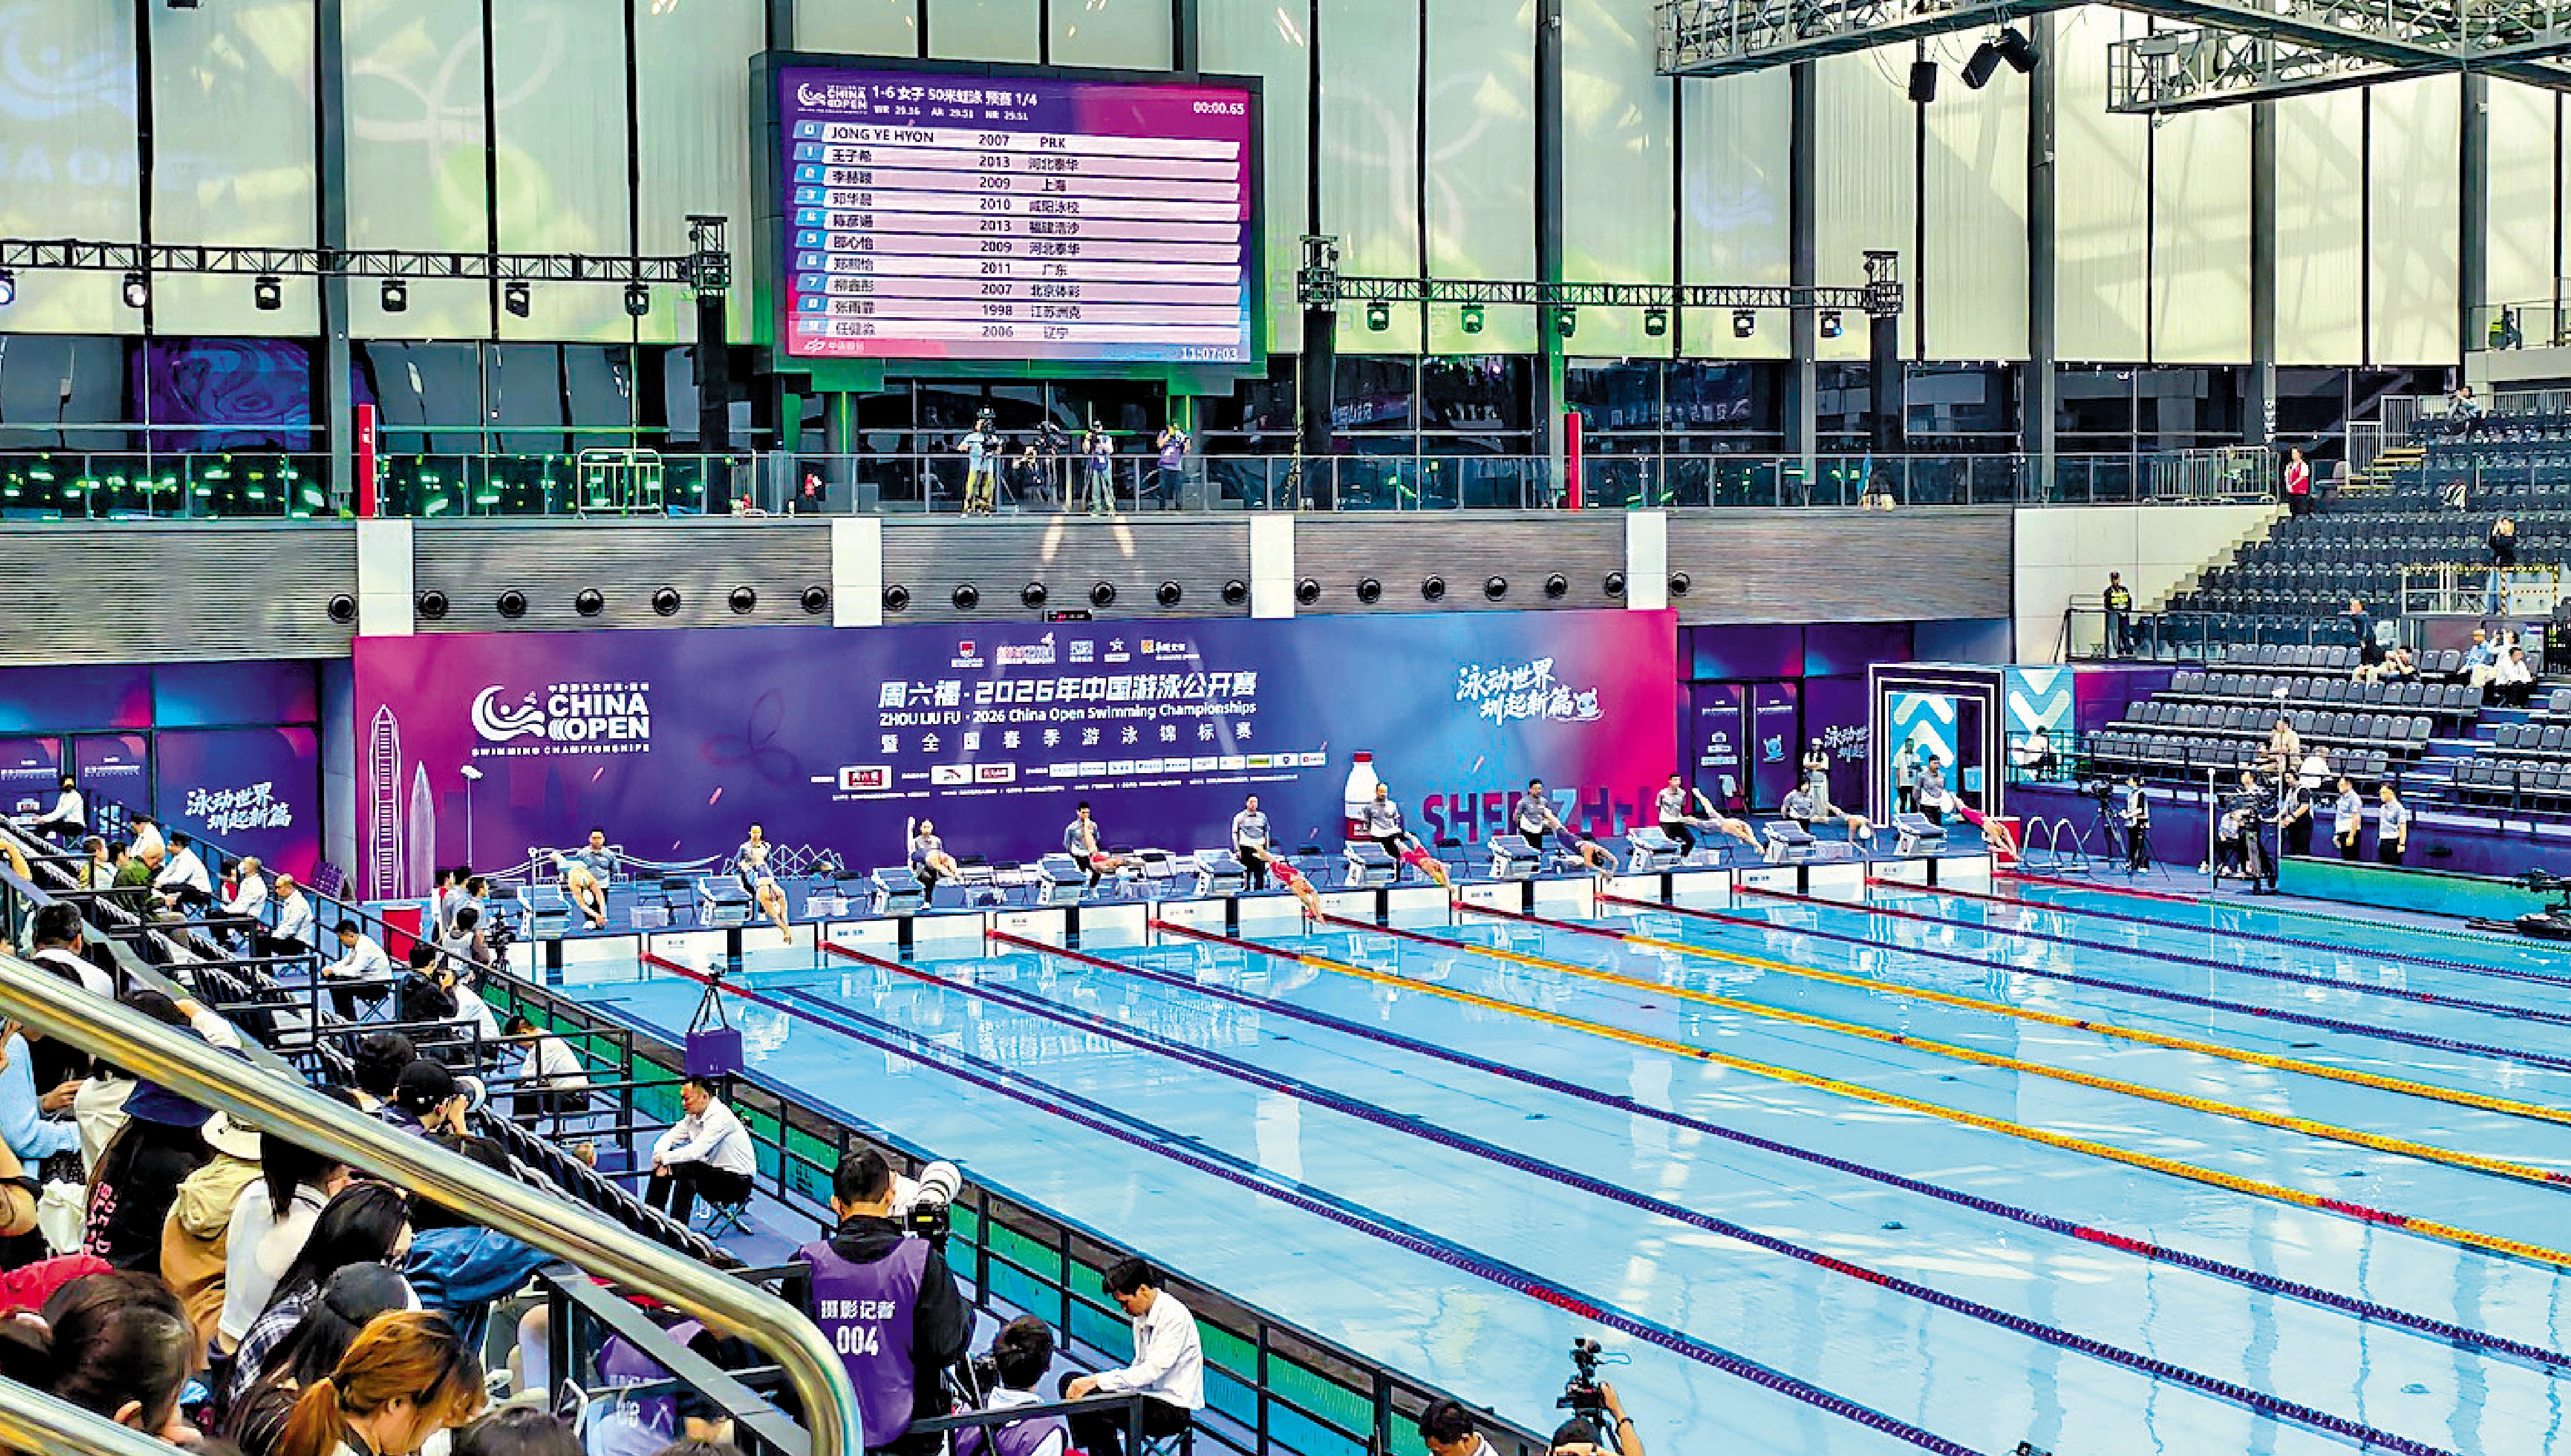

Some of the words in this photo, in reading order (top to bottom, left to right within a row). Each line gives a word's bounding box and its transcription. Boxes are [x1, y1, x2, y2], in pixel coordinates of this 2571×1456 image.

[873, 85, 894, 99] 1-6
[898, 87, 925, 101] 女子
[1015, 93, 1037, 106] 1/4
[832, 127, 870, 139] JONG
[873, 129, 890, 140] YE
[894, 131, 934, 142] HYON
[979, 134, 1010, 146] 2007
[1040, 137, 1067, 150] PRK
[979, 155, 1010, 168] 2013
[980, 177, 1010, 190] 2009
[980, 198, 1012, 210] 2010
[980, 220, 1012, 232] 2013
[980, 240, 1012, 254] 2009
[980, 262, 1011, 274] 2011
[1042, 264, 1069, 278] 广东
[982, 284, 1012, 296] 2007
[982, 304, 1013, 316] 1998
[982, 326, 1014, 338] 2006
[1180, 348, 1238, 361] 11:07:03
[1456, 658, 1556, 701] 泳动世界
[548, 692, 650, 717] CHINA
[880, 711, 918, 726] ZHOU
[920, 710, 941, 725] LIU
[944, 710, 961, 725] FU
[972, 709, 1006, 724] 2026
[1009, 707, 1046, 722] China
[1049, 706, 1085, 722] Open
[1088, 703, 1156, 721] Swimming
[1159, 700, 1256, 718] Championships
[1480, 686, 1576, 725] 圳起新篇
[551, 717, 650, 740] OPEN
[185, 782, 275, 815] 泳动世界
[207, 802, 292, 836] 圳起新篇
[821, 1300, 896, 1320] 摄影记者
[836, 1325, 879, 1356] 004
